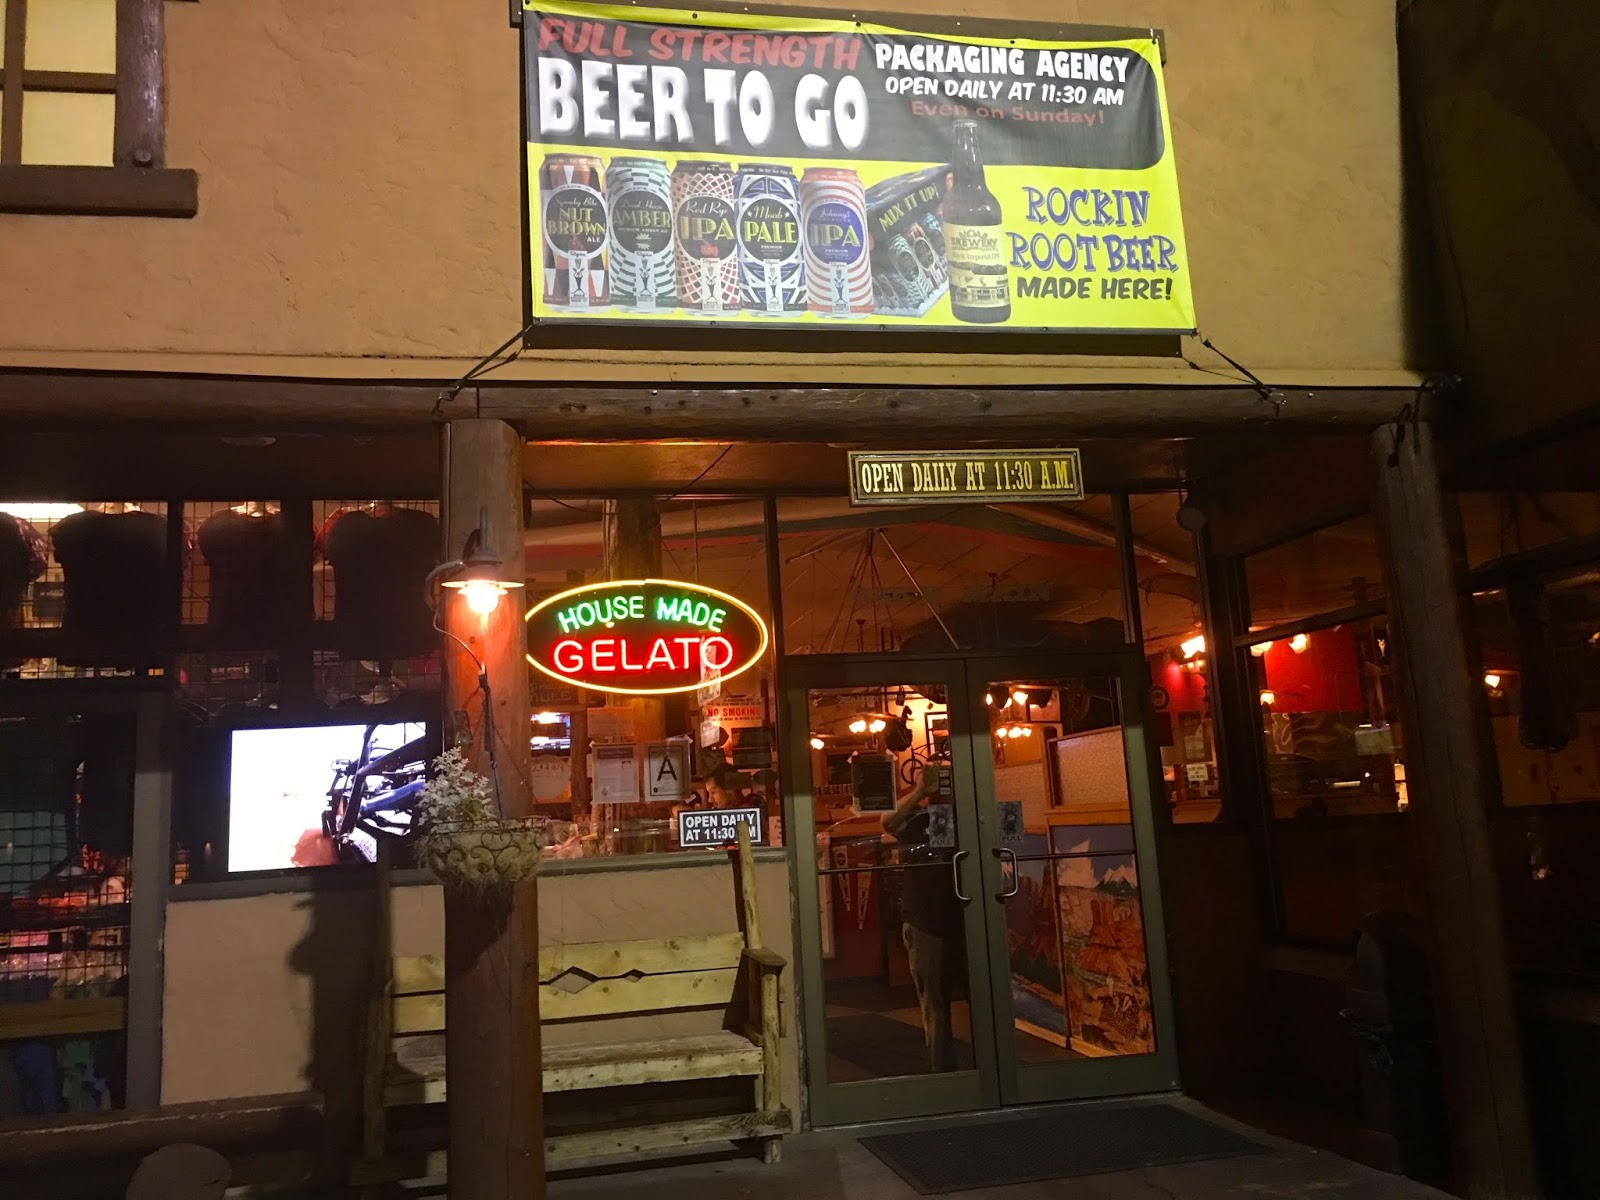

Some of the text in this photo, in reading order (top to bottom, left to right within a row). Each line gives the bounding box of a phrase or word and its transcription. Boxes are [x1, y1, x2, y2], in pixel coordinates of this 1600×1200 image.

[538, 18, 861, 71] FULL STRENGTH
[875, 43, 1129, 83] PACKAGING AGENCY
[886, 76, 1125, 106] OPEN DAILY AT 11:30 AM
[538, 57, 870, 151] BEER TO GO
[911, 100, 1105, 127] Even on Sunday!
[560, 207, 593, 221] NUT
[613, 209, 671, 228] AMBER
[685, 201, 729, 217] Red Rye
[753, 205, 783, 219] Moab
[878, 182, 940, 232] MIX IT UP!
[1022, 186, 1150, 227] ROCKIN
[548, 220, 606, 236] BROWN
[679, 216, 736, 241] IPA
[744, 220, 798, 244] PALE
[810, 224, 862, 248] IPA
[951, 237, 998, 248] BREWERY
[1005, 231, 1179, 273] ROOT BEER
[1017, 277, 1173, 301] MADE HERE!
[861, 460, 1074, 493] OPEN DAILY AT 11:30 A.M.
[557, 596, 727, 633] HOUSE MADE
[553, 636, 733, 673] GELATO
[707, 707, 761, 717] NO SMOKING
[657, 756, 677, 782] A
[685, 815, 718, 828] OPEN
[686, 829, 700, 841] AT
[704, 827, 735, 840] 11:30
